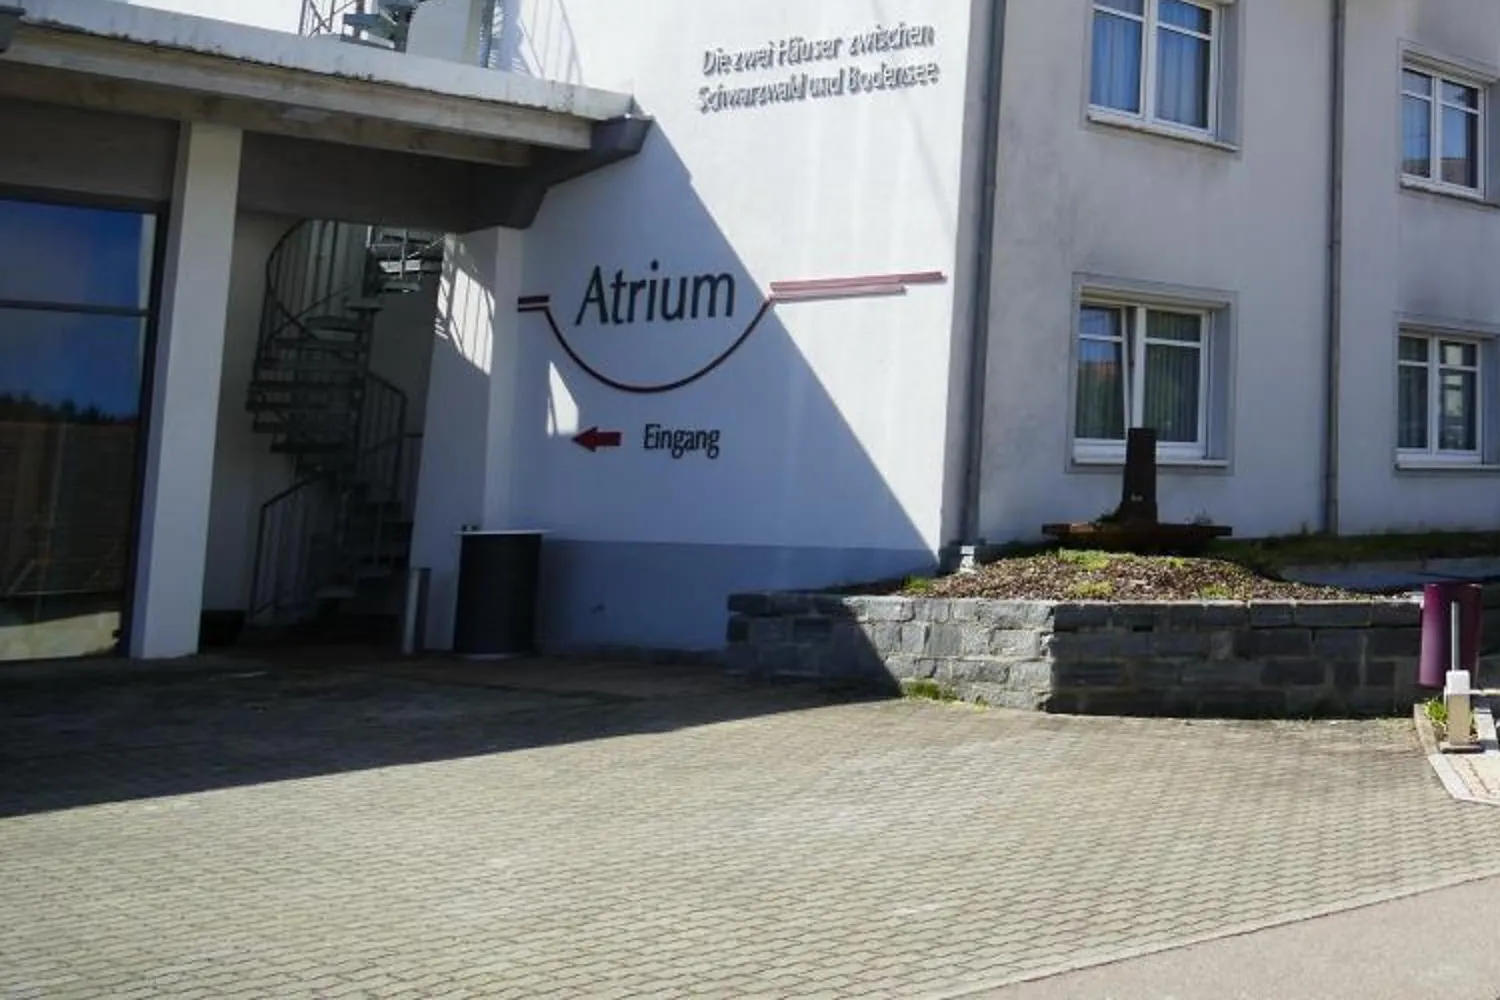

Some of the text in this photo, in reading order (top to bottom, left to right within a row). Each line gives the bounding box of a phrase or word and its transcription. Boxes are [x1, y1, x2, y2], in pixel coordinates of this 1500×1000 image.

[703, 22, 935, 76] Die zwei Häuser zwischen
[699, 61, 940, 113] Schwarzwald und Bodensee
[575, 259, 736, 326] Atrium
[644, 423, 720, 458] Eingang
